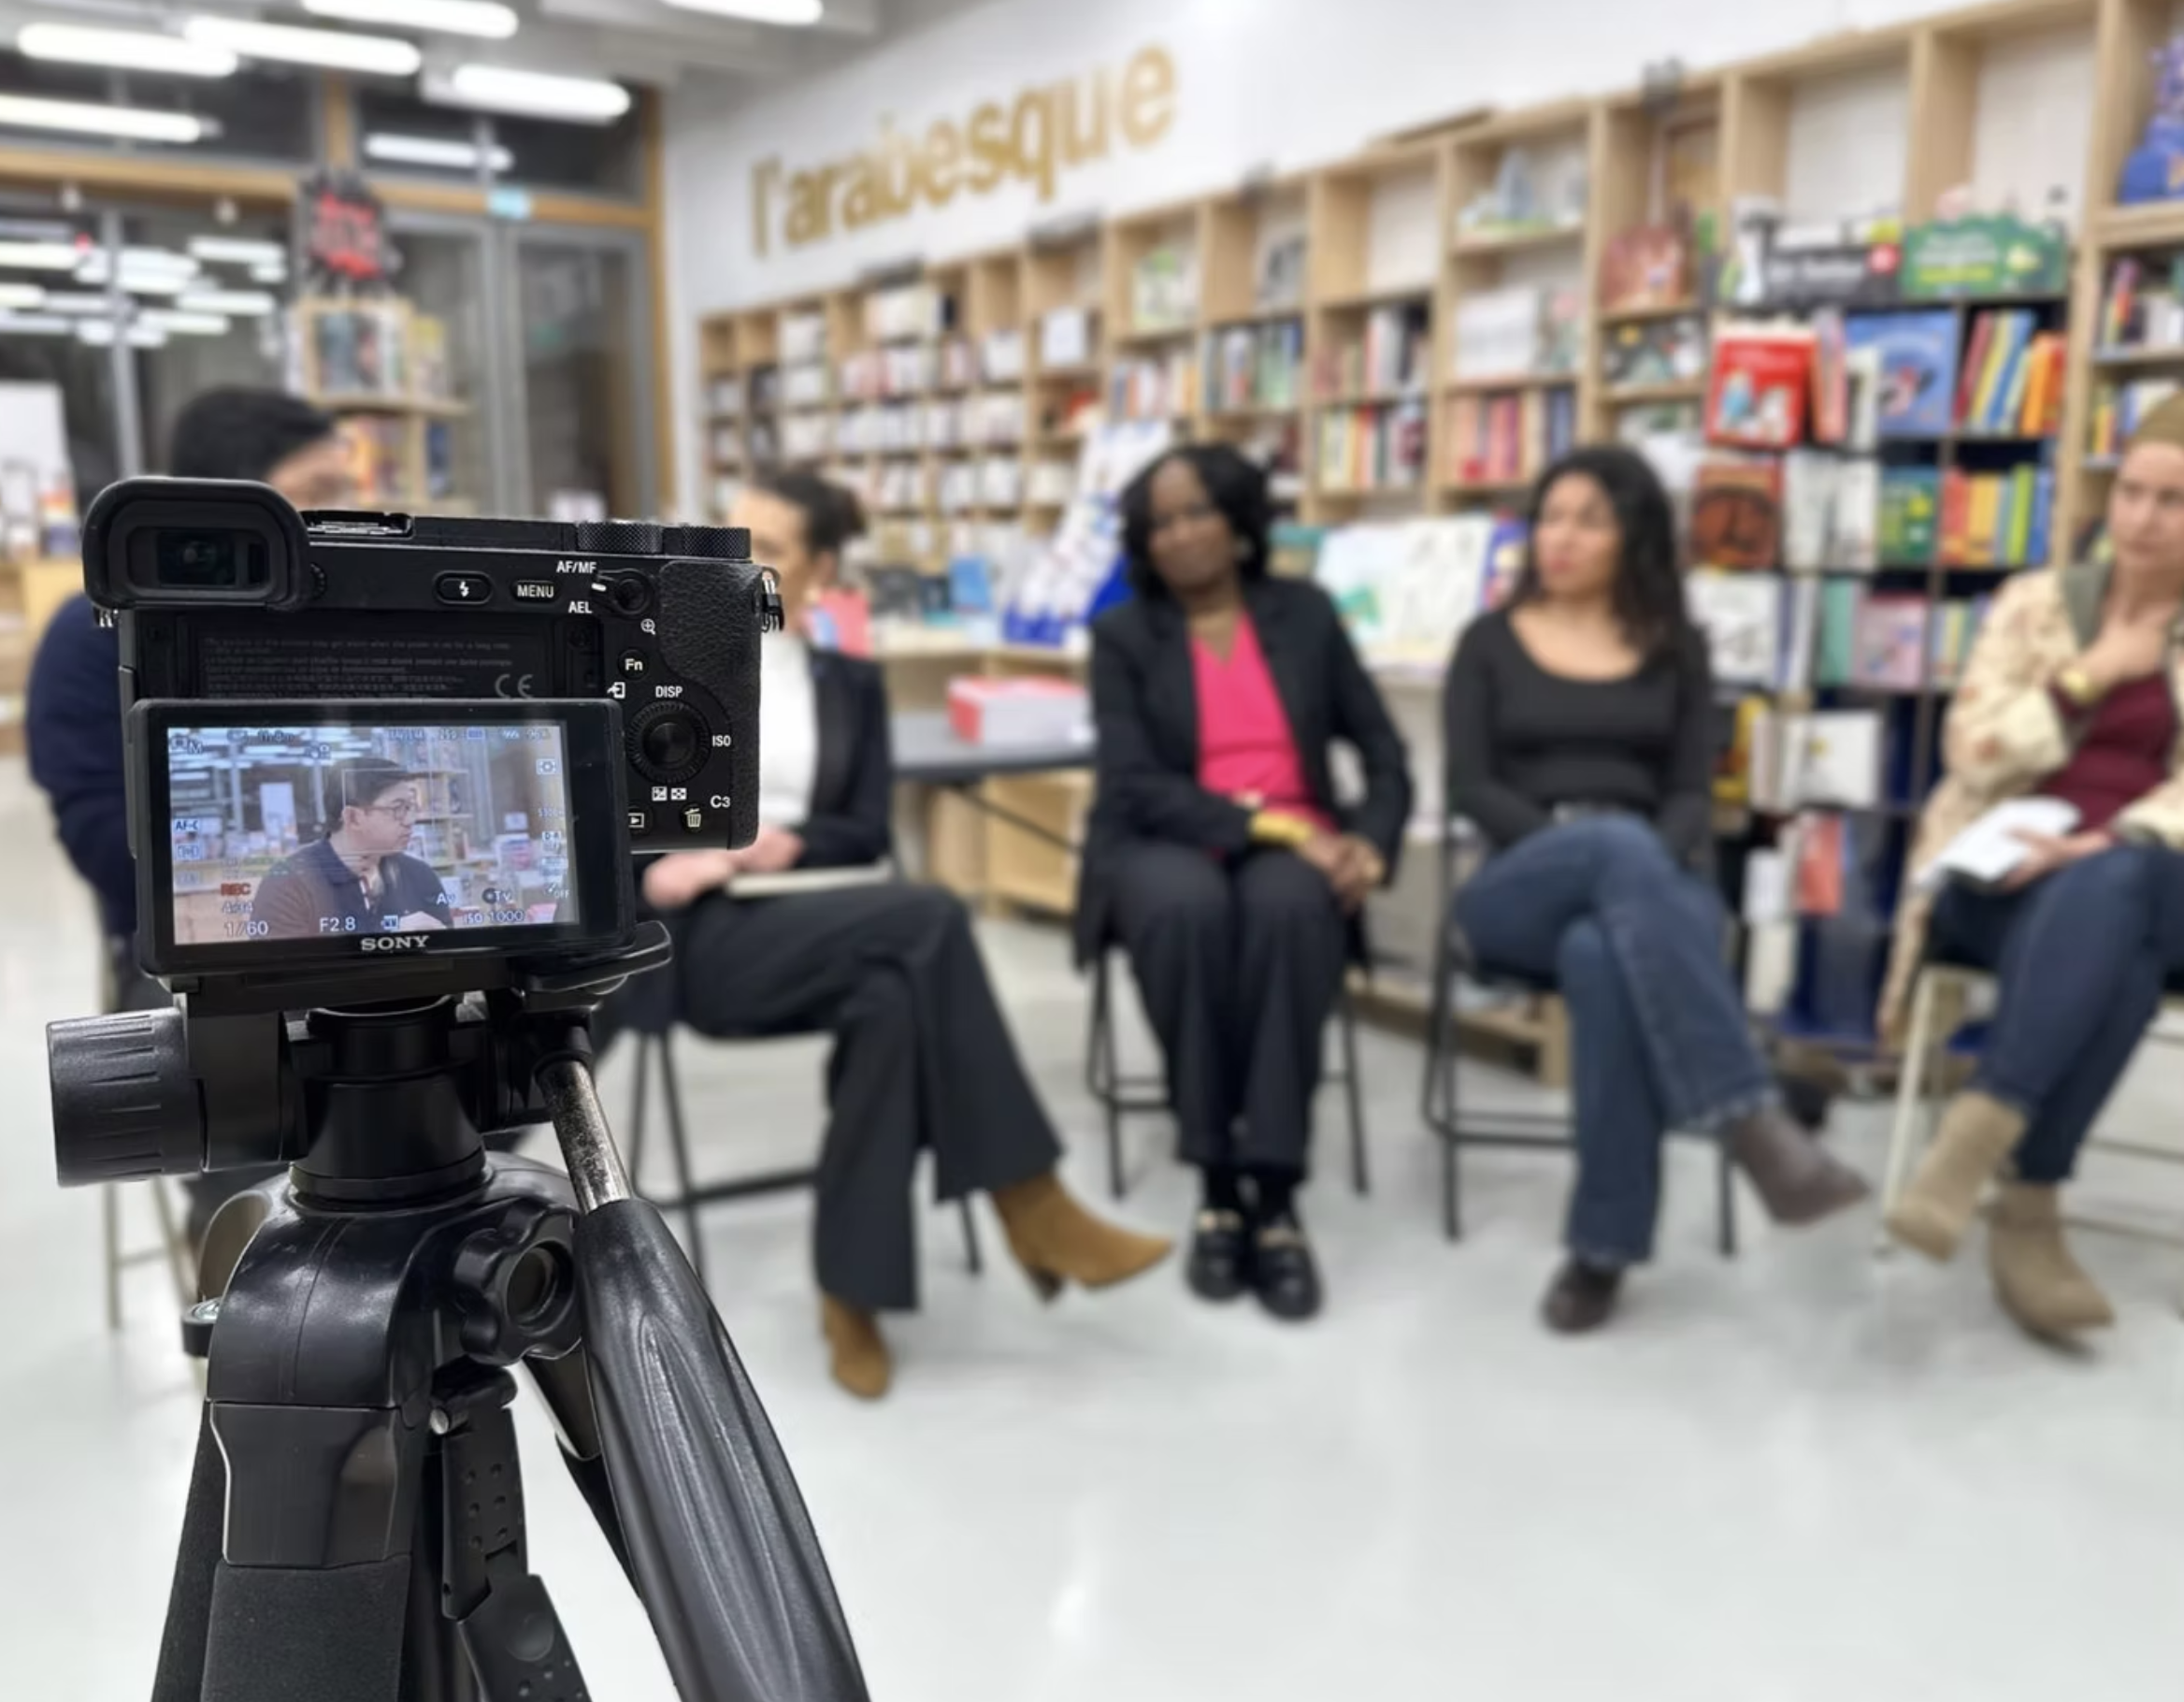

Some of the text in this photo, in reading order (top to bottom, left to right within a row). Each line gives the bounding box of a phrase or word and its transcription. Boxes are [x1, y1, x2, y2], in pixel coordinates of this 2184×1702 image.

[555, 560, 597, 574] AF/MF
[517, 584, 554, 599] MENU
[568, 601, 593, 613] AEL
[625, 658, 643, 671] Fn
[655, 685, 683, 699] DISP
[711, 735, 732, 747] ISO
[710, 795, 731, 809] C3
[319, 916, 356, 932] F2.8
[489, 911, 525, 923] 1000
[224, 920, 269, 939] 1/60
[360, 935, 430, 952] SONY
